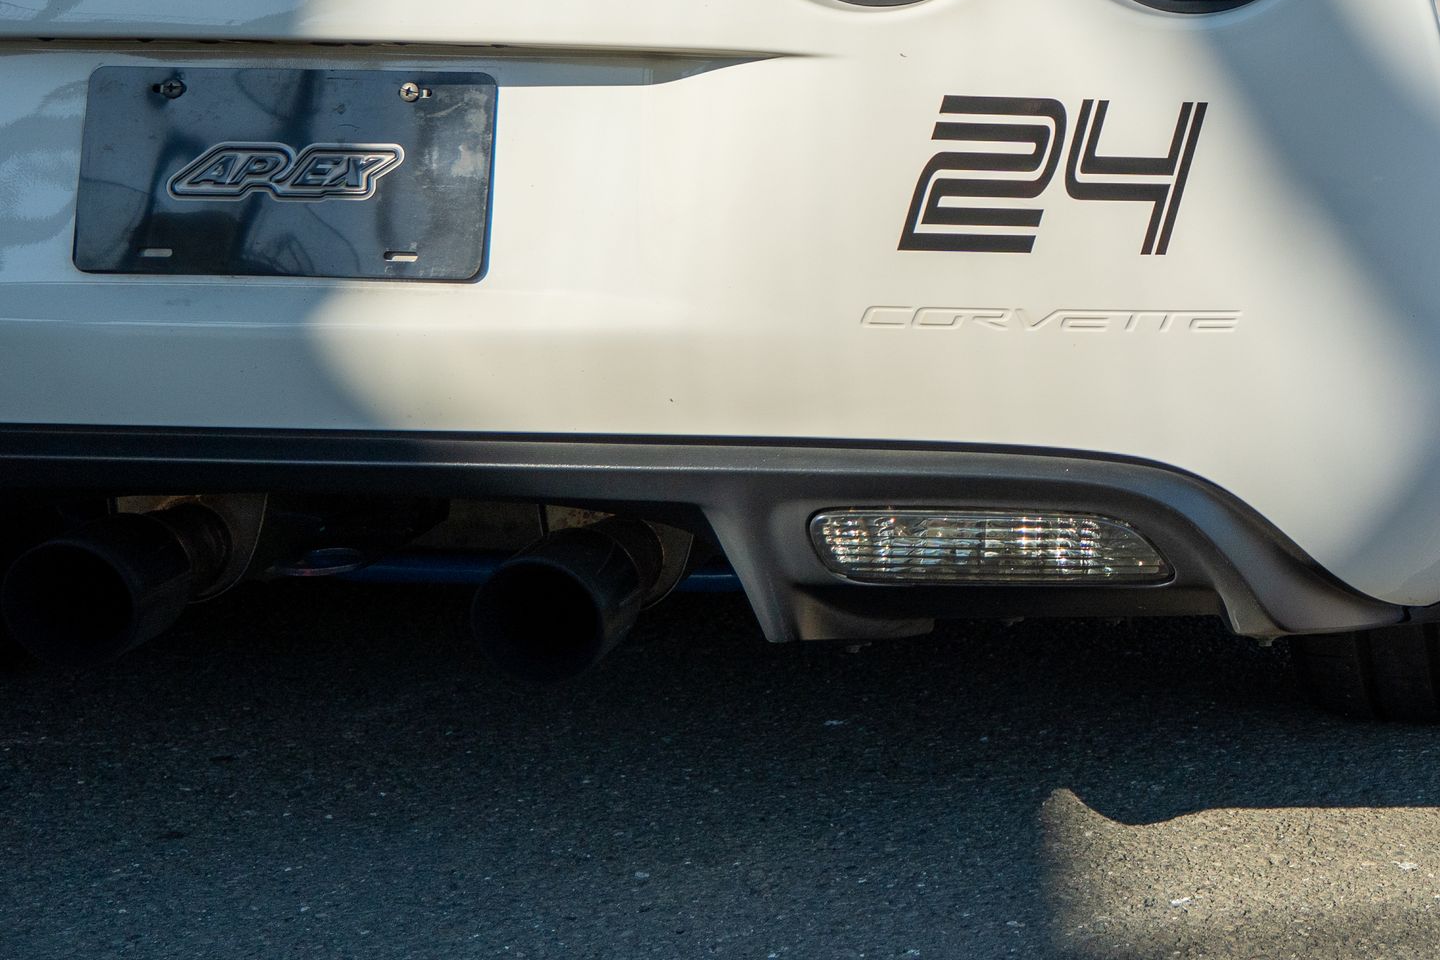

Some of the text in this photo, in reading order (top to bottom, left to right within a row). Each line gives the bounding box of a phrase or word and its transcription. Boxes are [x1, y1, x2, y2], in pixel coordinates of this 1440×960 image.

[178, 147, 398, 194] APEX
[897, 94, 1208, 256] 24
[860, 304, 1244, 333] CORVETTE
